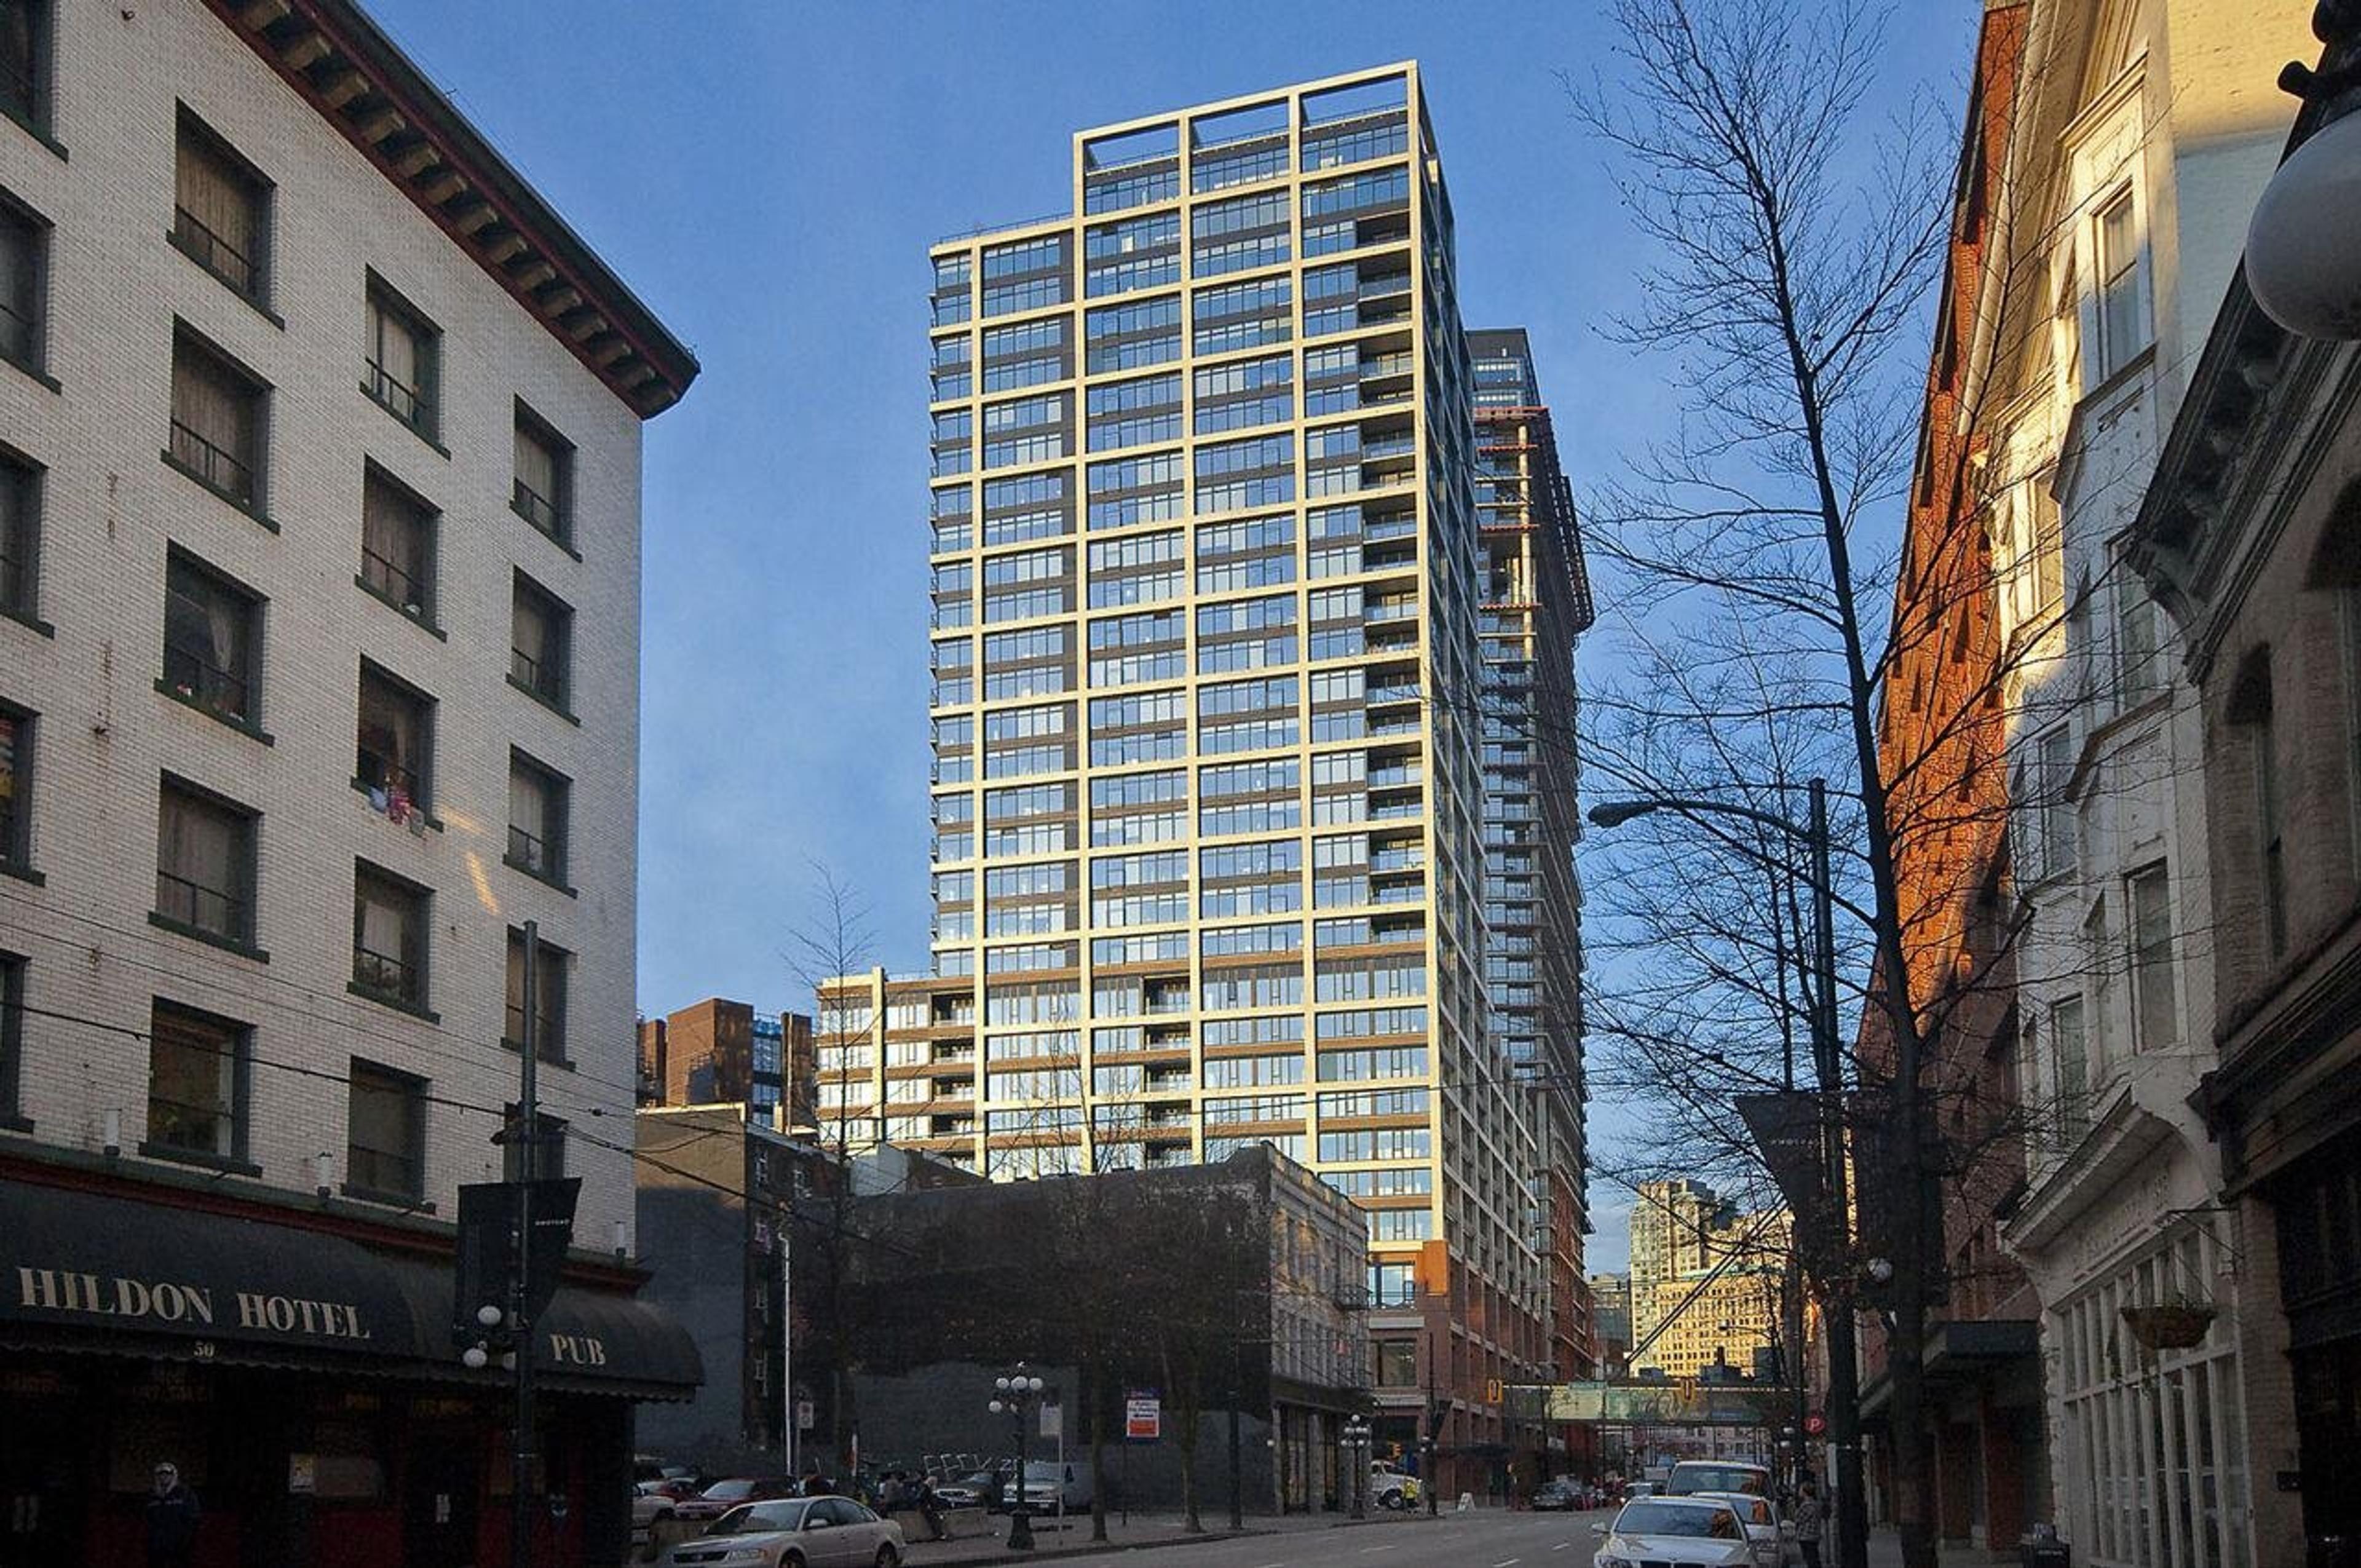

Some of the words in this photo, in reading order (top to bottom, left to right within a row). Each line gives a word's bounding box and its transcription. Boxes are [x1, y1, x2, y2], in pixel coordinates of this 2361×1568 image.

[18, 1267, 213, 1324] HILDON
[236, 1293, 370, 1339] HOTEL
[550, 1334, 606, 1365] PUB
[1809, 1417, 1821, 1431] P
